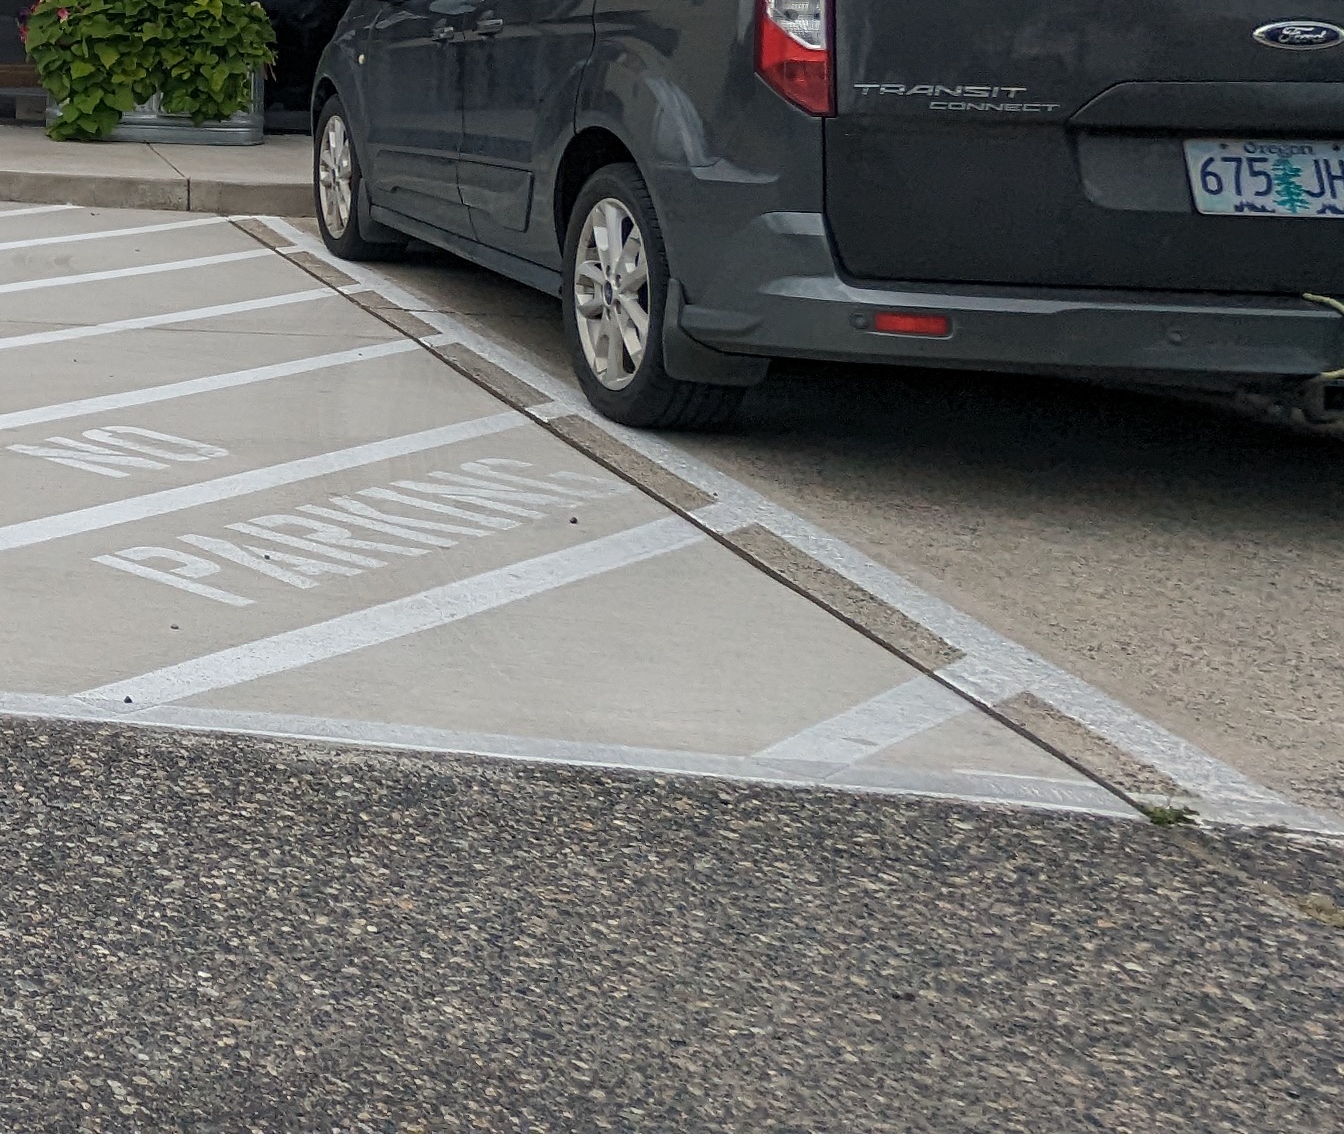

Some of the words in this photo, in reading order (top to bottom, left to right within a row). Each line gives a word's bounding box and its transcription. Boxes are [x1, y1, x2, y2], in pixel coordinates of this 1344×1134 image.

[1278, 26, 1327, 44] Ford
[853, 83, 1028, 99] TRANSIT
[929, 101, 1061, 112] CONNECT
[1243, 141, 1314, 158] Oregon
[1200, 156, 1273, 197] 675
[6, 425, 230, 479] NO
[90, 458, 635, 607] PARKING
